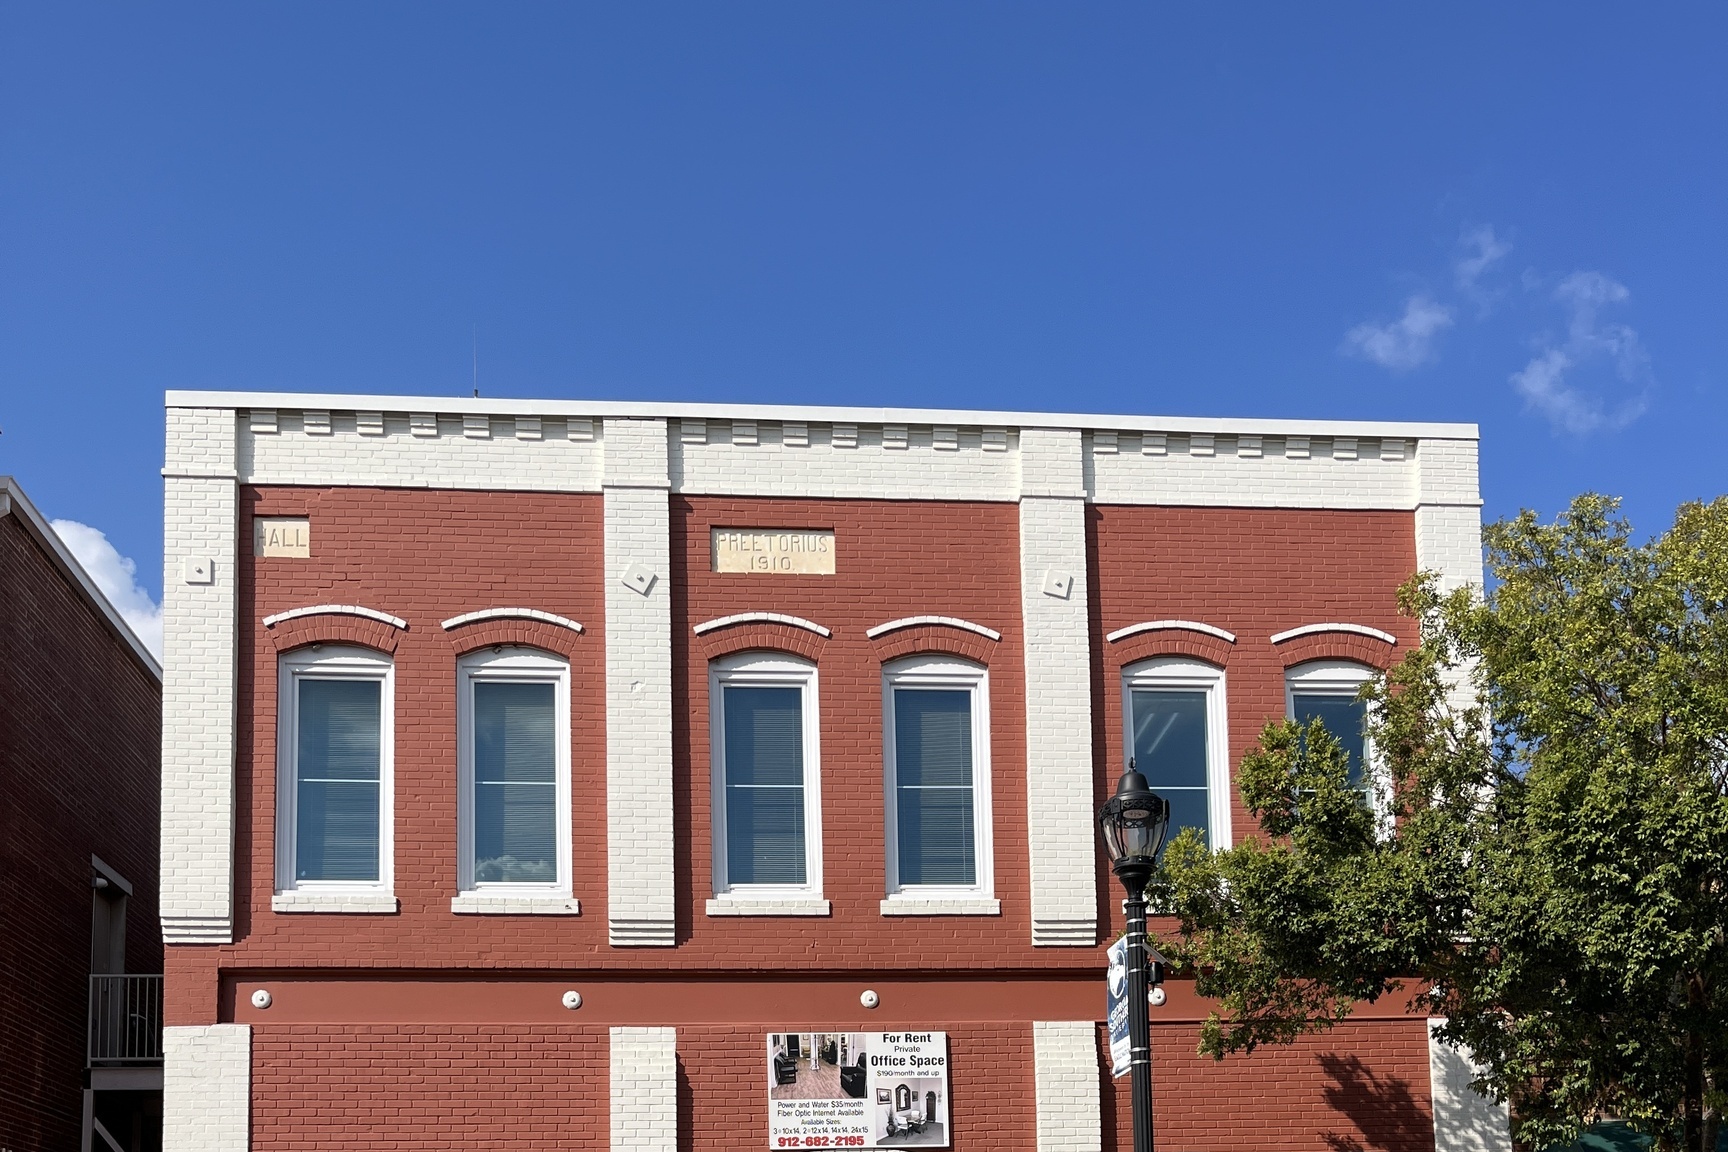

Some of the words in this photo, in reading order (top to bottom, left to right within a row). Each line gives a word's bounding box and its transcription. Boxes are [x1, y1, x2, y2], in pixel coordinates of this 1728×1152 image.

[257, 528, 307, 547] HALL
[718, 534, 828, 552] PREETORIUS
[883, 1033, 901, 1043] For
[905, 1033, 932, 1043] Rent
[871, 1055, 906, 1066] Office
[909, 1055, 945, 1068] Space
[831, 1100, 864, 1108] $35/month
[795, 1109, 811, 1117] Optic
[777, 1136, 865, 1147] 912-682-2195
